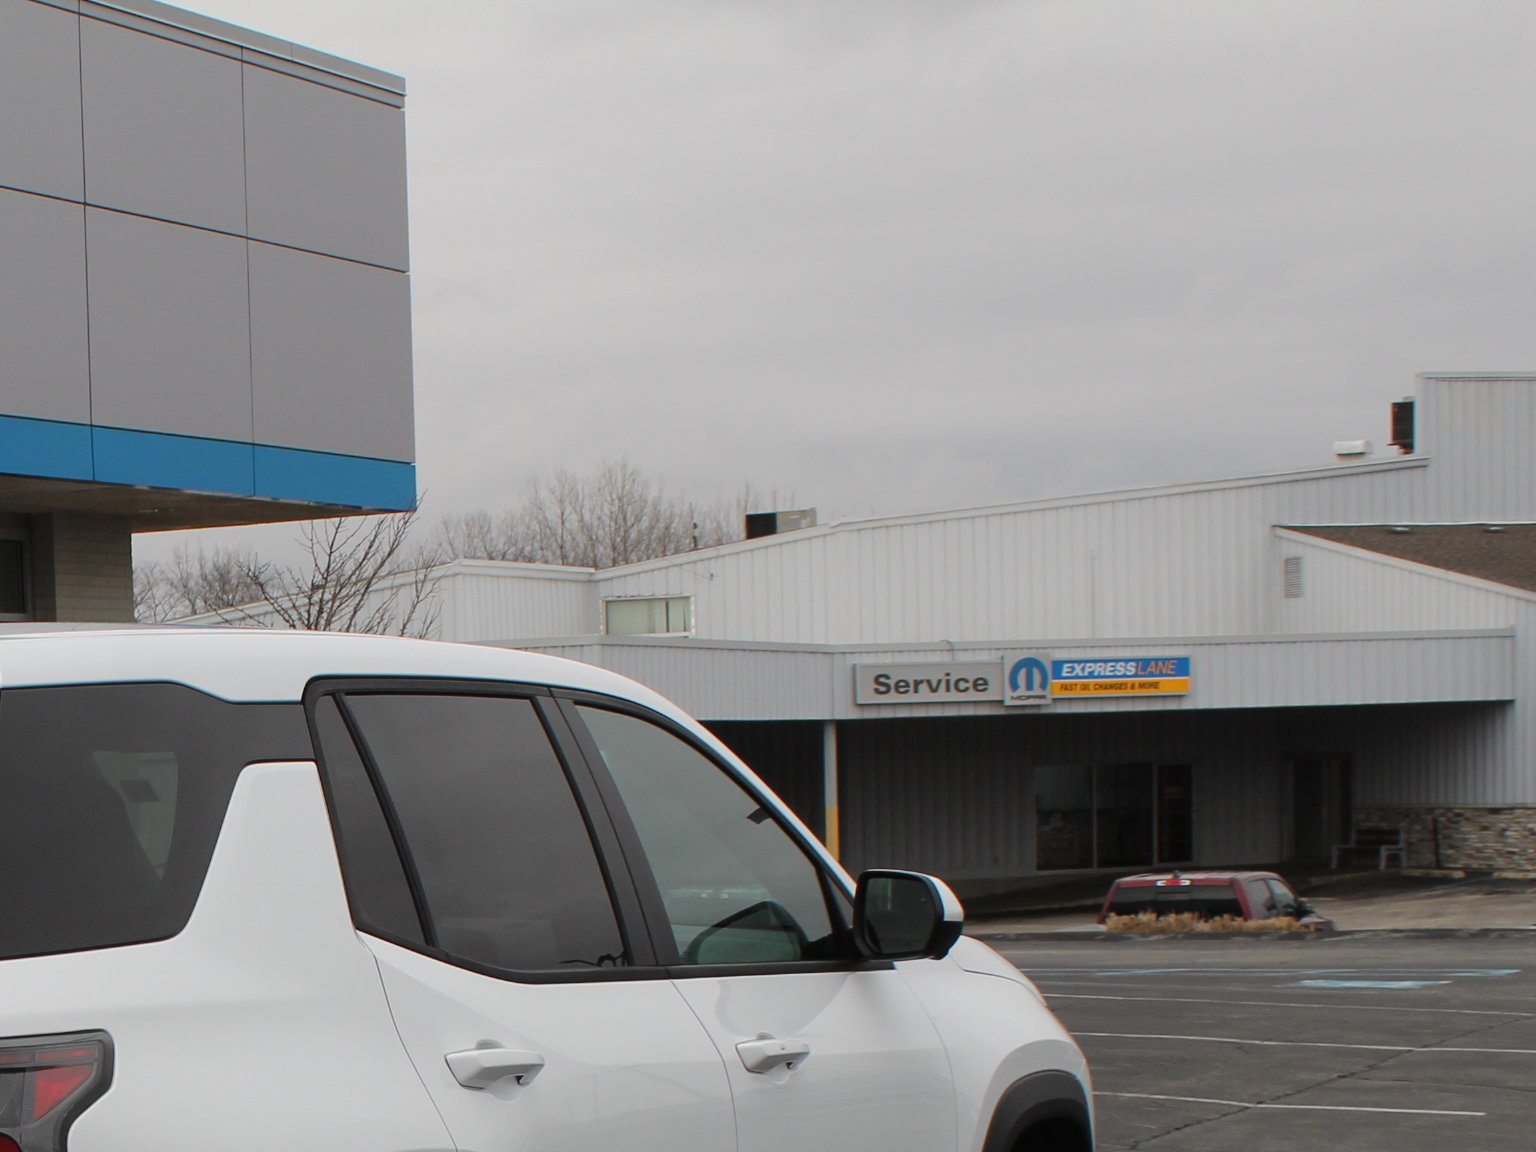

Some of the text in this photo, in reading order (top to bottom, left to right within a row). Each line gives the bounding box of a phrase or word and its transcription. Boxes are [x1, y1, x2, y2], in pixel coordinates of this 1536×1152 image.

[872, 672, 989, 695] Service
[1060, 682, 1078, 692] FAST
[1080, 682, 1091, 692] OIL
[1093, 681, 1129, 691] CHANGES
[1138, 680, 1160, 690] MORE
